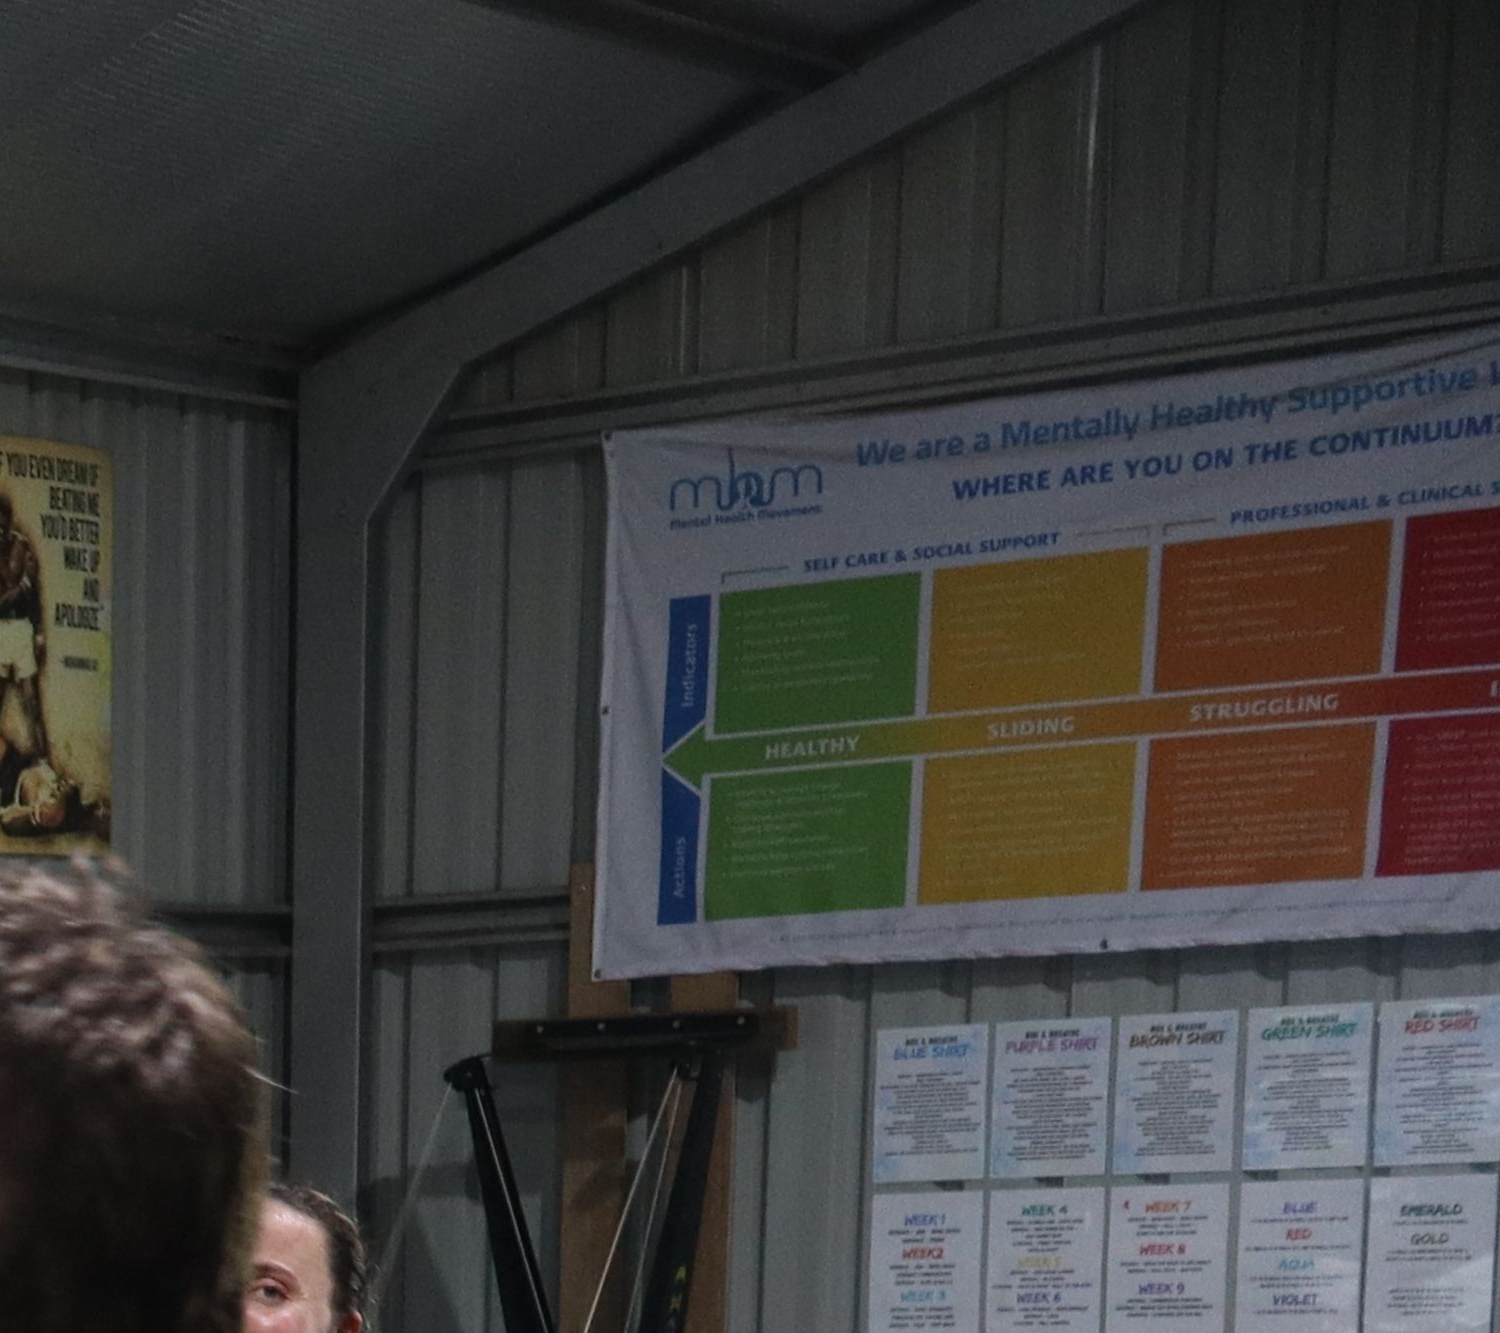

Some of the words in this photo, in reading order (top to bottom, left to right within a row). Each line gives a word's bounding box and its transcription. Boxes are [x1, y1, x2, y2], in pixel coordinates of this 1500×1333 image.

[856, 439, 907, 467] We
[916, 433, 964, 460] are
[973, 432, 992, 455] a
[1001, 406, 1141, 448] Mentally
[1151, 392, 1279, 431] Healthy
[1287, 367, 1479, 415] Supportive
[952, 469, 1051, 501] WHERE
[1060, 461, 1114, 487] ARE
[1125, 453, 1183, 479] YOU
[1193, 448, 1234, 473] ON
[1244, 438, 1299, 465] THE
[1229, 496, 1370, 525] PROFESSIONAL
[1377, 494, 1392, 508] &
[1400, 483, 1484, 506] CLINICAL
[804, 556, 838, 574] SELF
[845, 550, 889, 569] CARE
[894, 548, 908, 562] &
[913, 540, 974, 562] SOCIAL
[979, 531, 1061, 554] SUPPORT
[680, 622, 700, 709] Indicators
[764, 736, 861, 761] HEALTHY
[987, 714, 1077, 740] SLIDING
[1190, 692, 1341, 722] STRUGGLING
[673, 836, 687, 899] Actions
[1261, 1026, 1311, 1041] GREEN
[1315, 1023, 1357, 1039] SHIRT
[1404, 1019, 1434, 1034] RED
[1438, 1016, 1480, 1032] SHIRT
[1005, 1038, 1056, 1053] PURPLE
[1061, 1036, 1100, 1050] SHIRT
[1130, 1032, 1182, 1048] BROWN
[1187, 1030, 1225, 1044] SHIRT
[1021, 1205, 1054, 1217] WEEK
[1058, 1205, 1068, 1215] 4
[1283, 1201, 1318, 1213] BLUE
[1399, 1203, 1463, 1217] EMERALD
[1286, 1228, 1312, 1241] RED
[1410, 1232, 1449, 1246] GOLD
[1140, 1243, 1174, 1255] WEEK
[1138, 1283, 1172, 1295] WEEK
[1176, 1282, 1186, 1295] 9
[1016, 1292, 1049, 1304] WEEK
[1272, 1293, 1318, 1306] VIOLET
